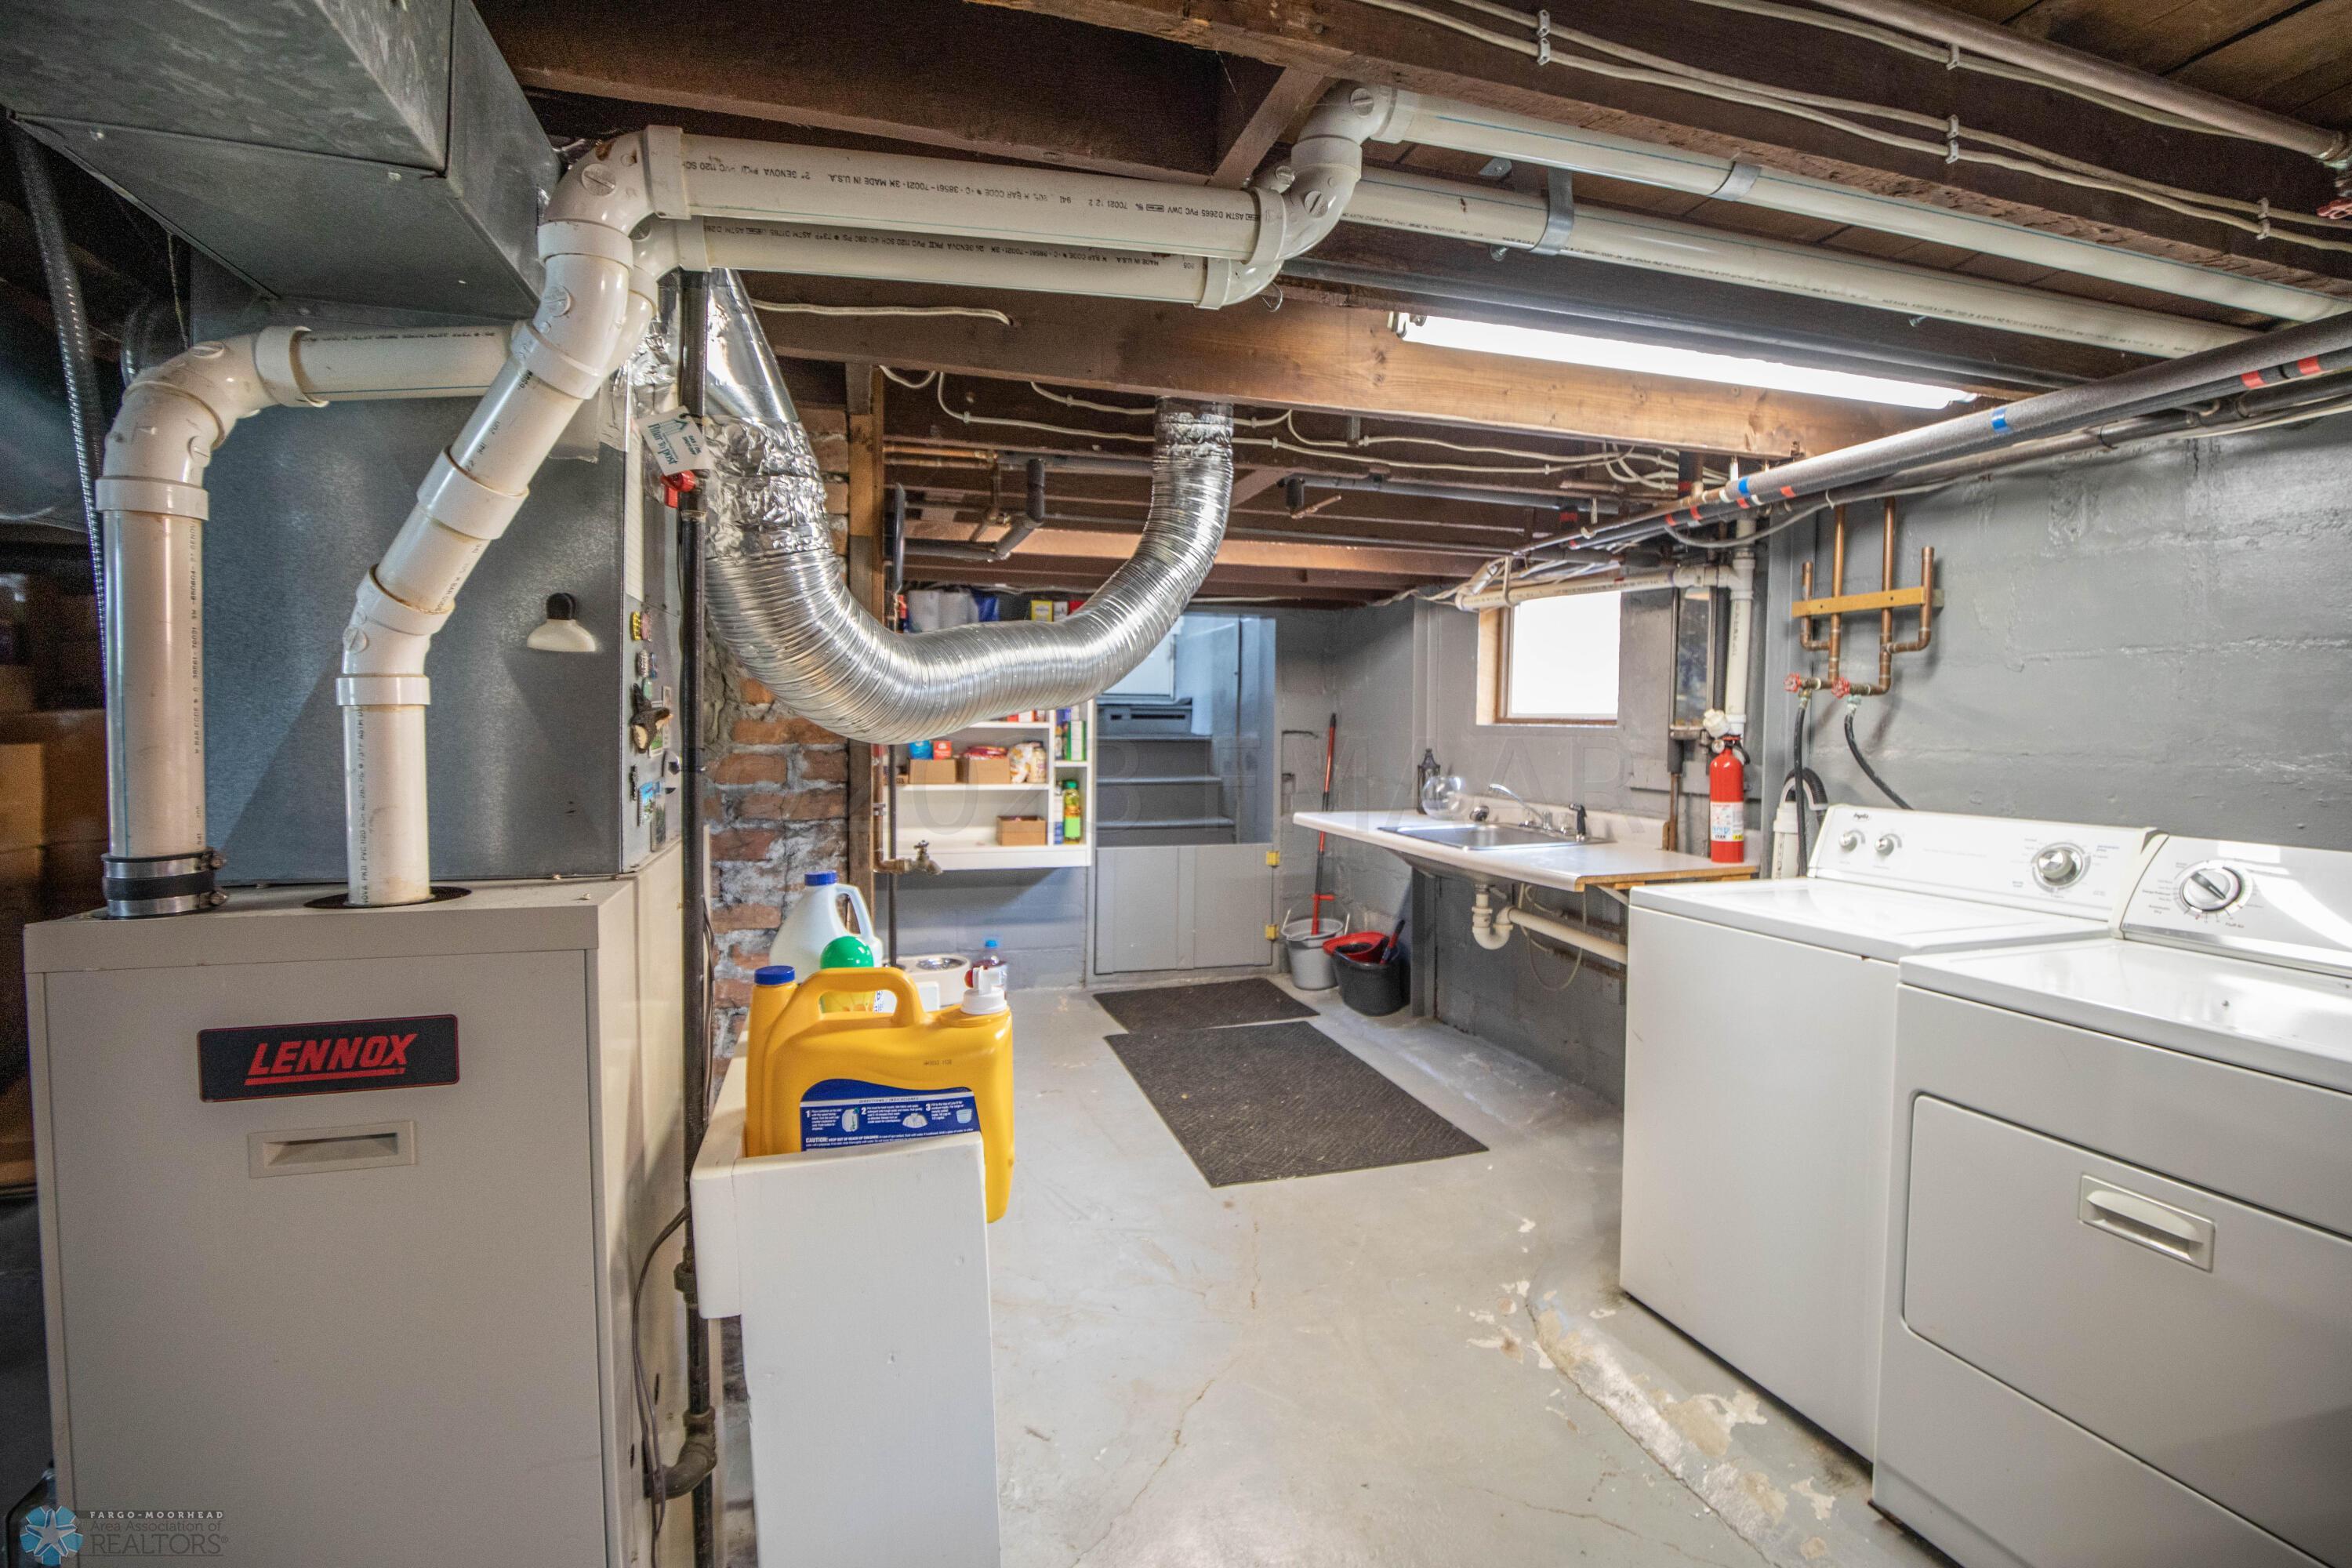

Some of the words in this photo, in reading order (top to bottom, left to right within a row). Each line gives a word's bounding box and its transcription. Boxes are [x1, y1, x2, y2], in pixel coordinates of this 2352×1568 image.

[764, 168, 797, 179] GENOVA
[864, 177, 887, 186] MADE
[247, 1033, 417, 1076] LENNOX
